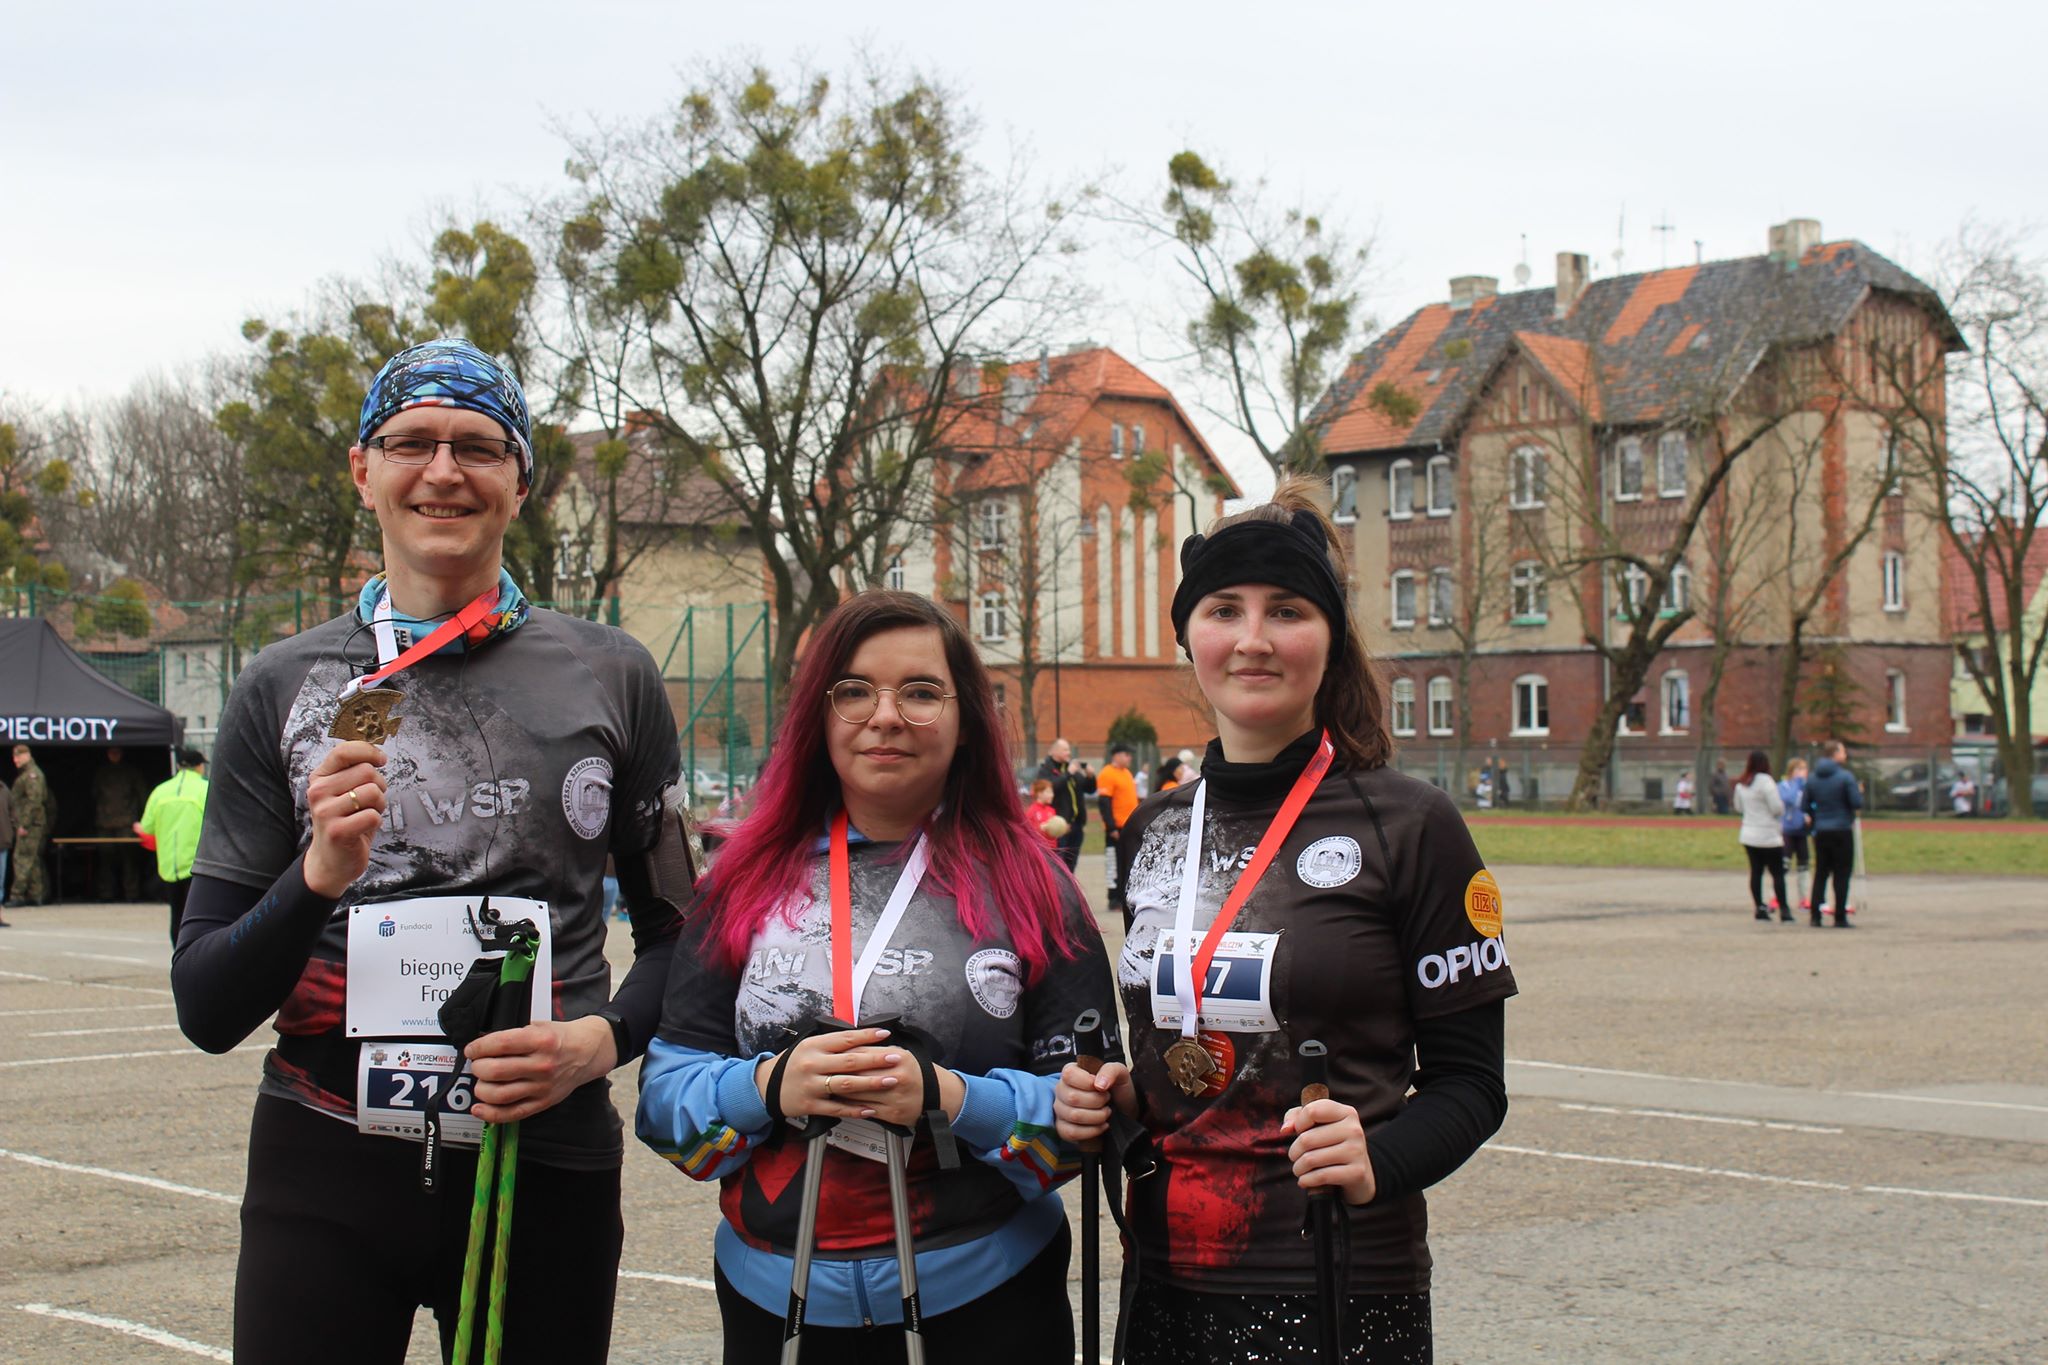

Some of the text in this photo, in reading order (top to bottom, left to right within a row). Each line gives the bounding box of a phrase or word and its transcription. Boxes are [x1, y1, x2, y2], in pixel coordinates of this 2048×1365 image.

[417, 778, 531, 825] WSP
[1210, 844, 1274, 873] WS
[400, 922, 432, 931] Fundacja
[976, 950, 1003, 959] SZKOŁA
[400, 958, 464, 981] biegnę
[389, 1072, 472, 1111] 216
[424, 1177, 432, 1187] R
[793, 1300, 802, 1335] Explorer
